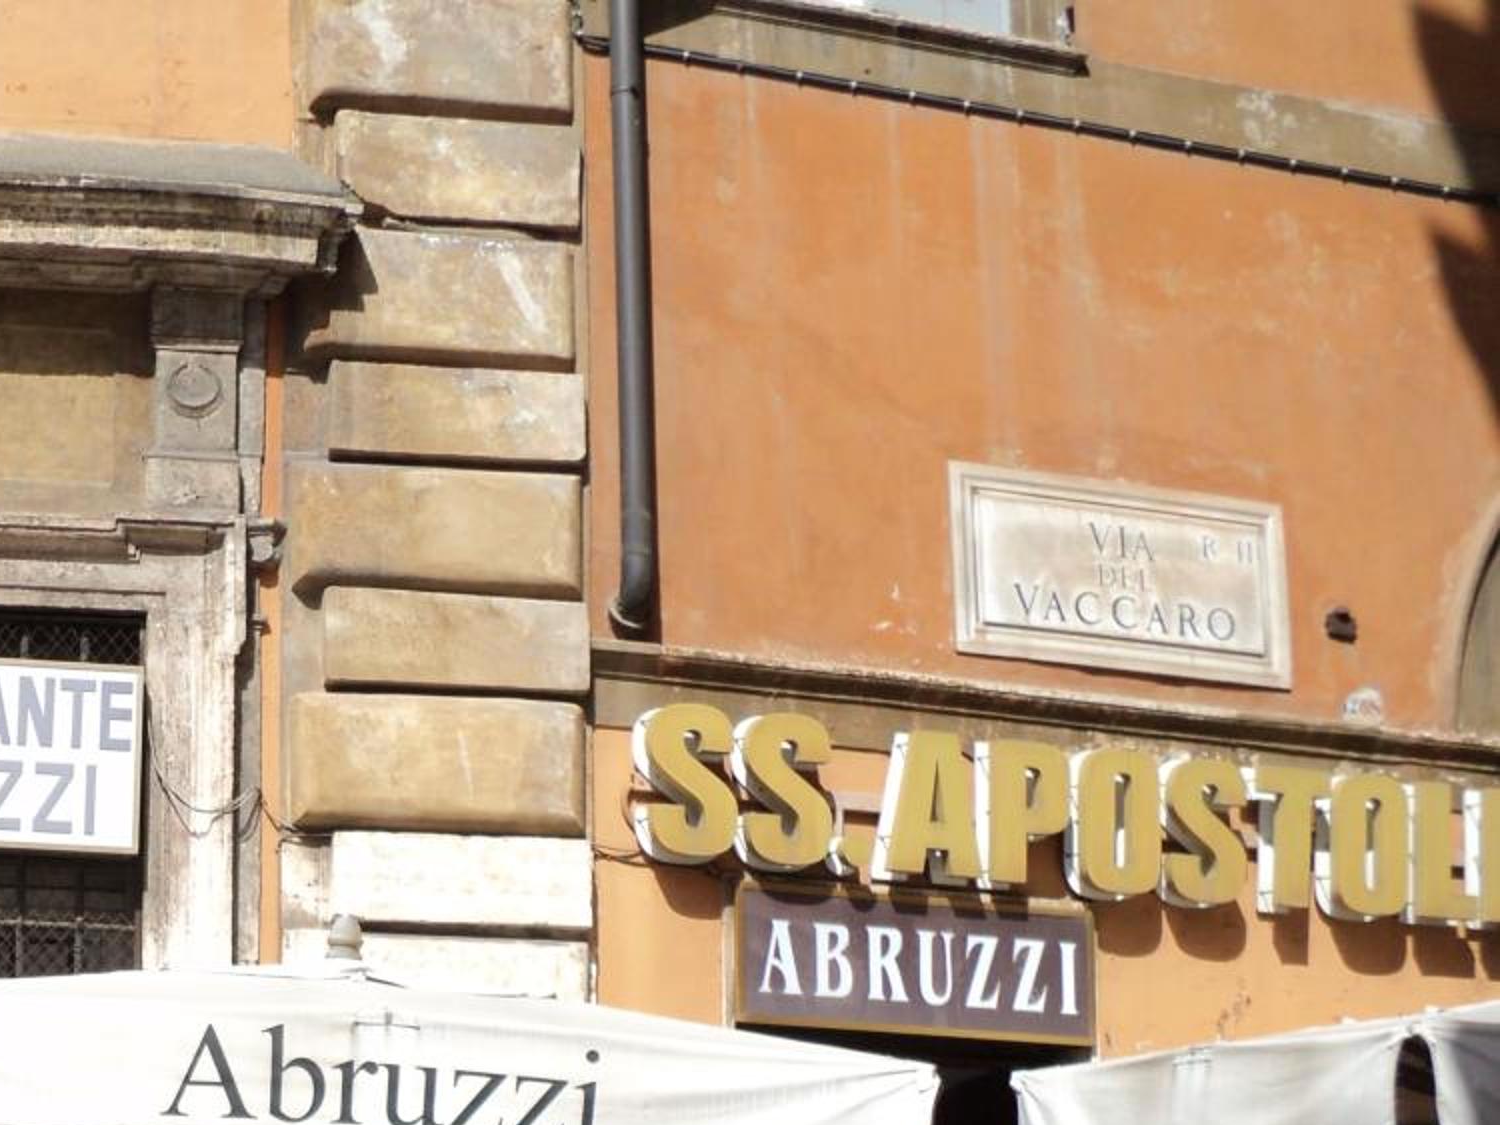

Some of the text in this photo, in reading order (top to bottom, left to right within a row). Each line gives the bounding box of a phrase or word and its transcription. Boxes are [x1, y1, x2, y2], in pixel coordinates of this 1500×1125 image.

[1088, 521, 1155, 562] VIA
[1013, 582, 1236, 641] VACCARO
[758, 918, 1080, 1017] ABRUZZI
